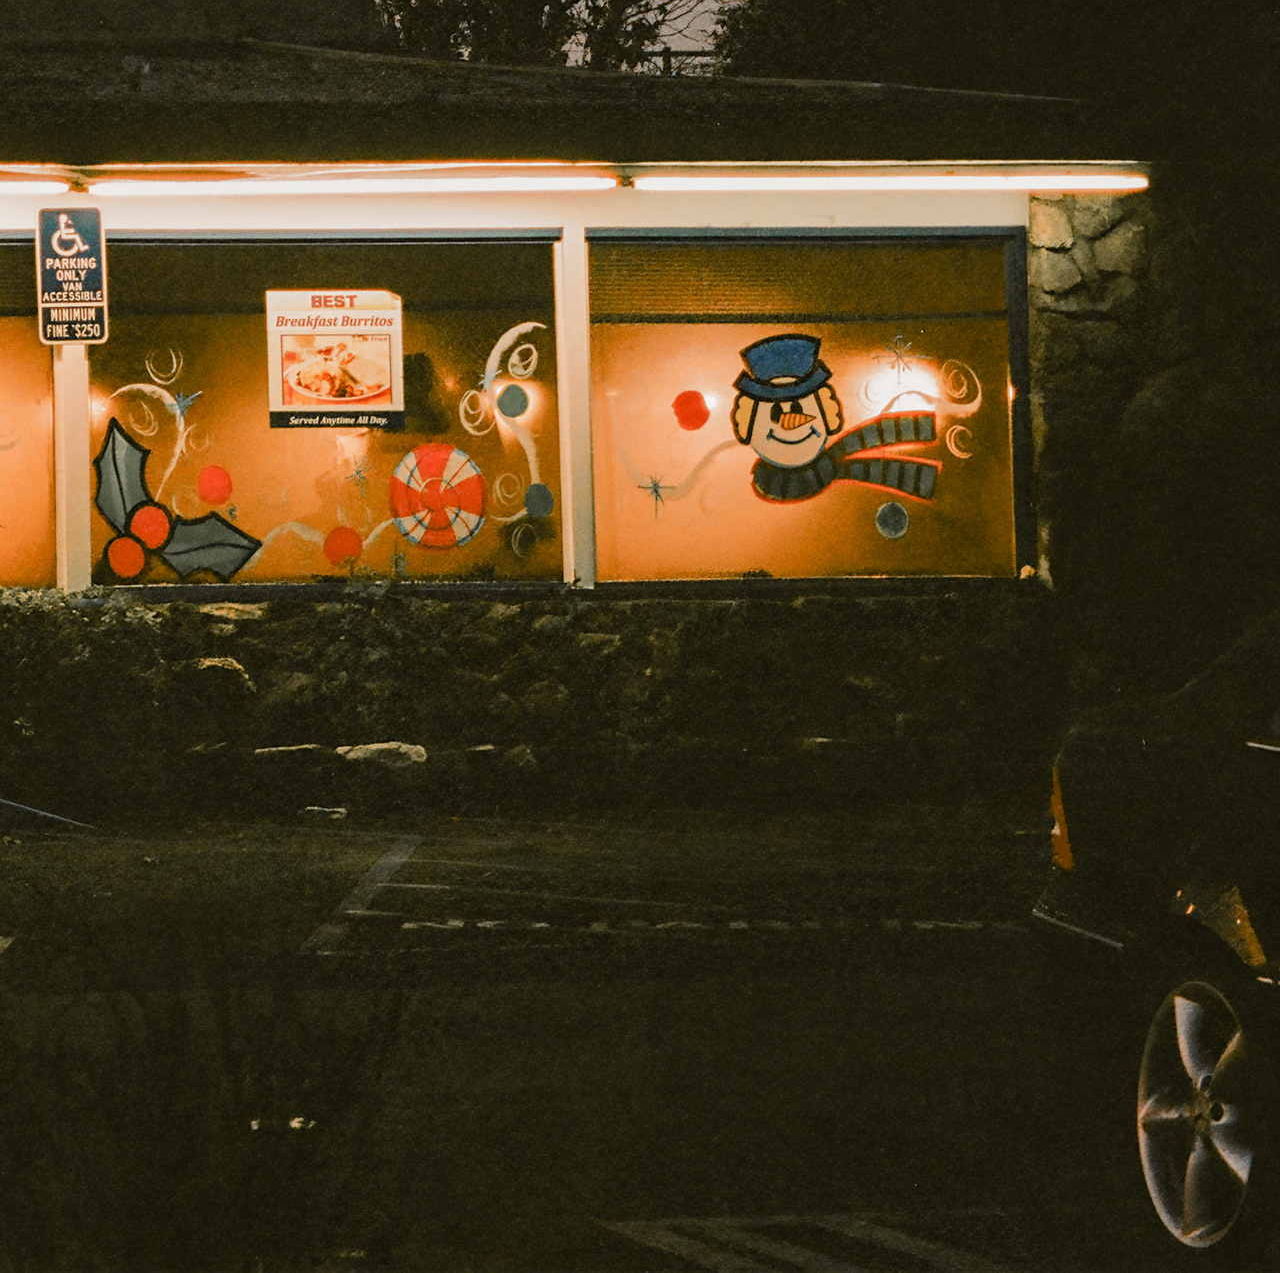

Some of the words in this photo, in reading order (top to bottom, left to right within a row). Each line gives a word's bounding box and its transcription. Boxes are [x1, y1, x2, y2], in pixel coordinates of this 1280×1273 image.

[45, 257, 96, 269] PARKING
[56, 269, 87, 281] ONLY
[62, 282, 82, 291] VAN
[43, 291, 102, 301] ACCESSIBLE
[311, 295, 357, 308] BEST
[50, 307, 96, 321] MINIMUM
[275, 315, 338, 329] Breakfast
[341, 315, 393, 327] Burritos
[46, 325, 69, 337] FINE
[73, 323, 100, 337] $250
[289, 416, 319, 425] Served
[320, 416, 356, 426] Anytime
[357, 415, 368, 424] All
[370, 416, 388, 426] Day.
